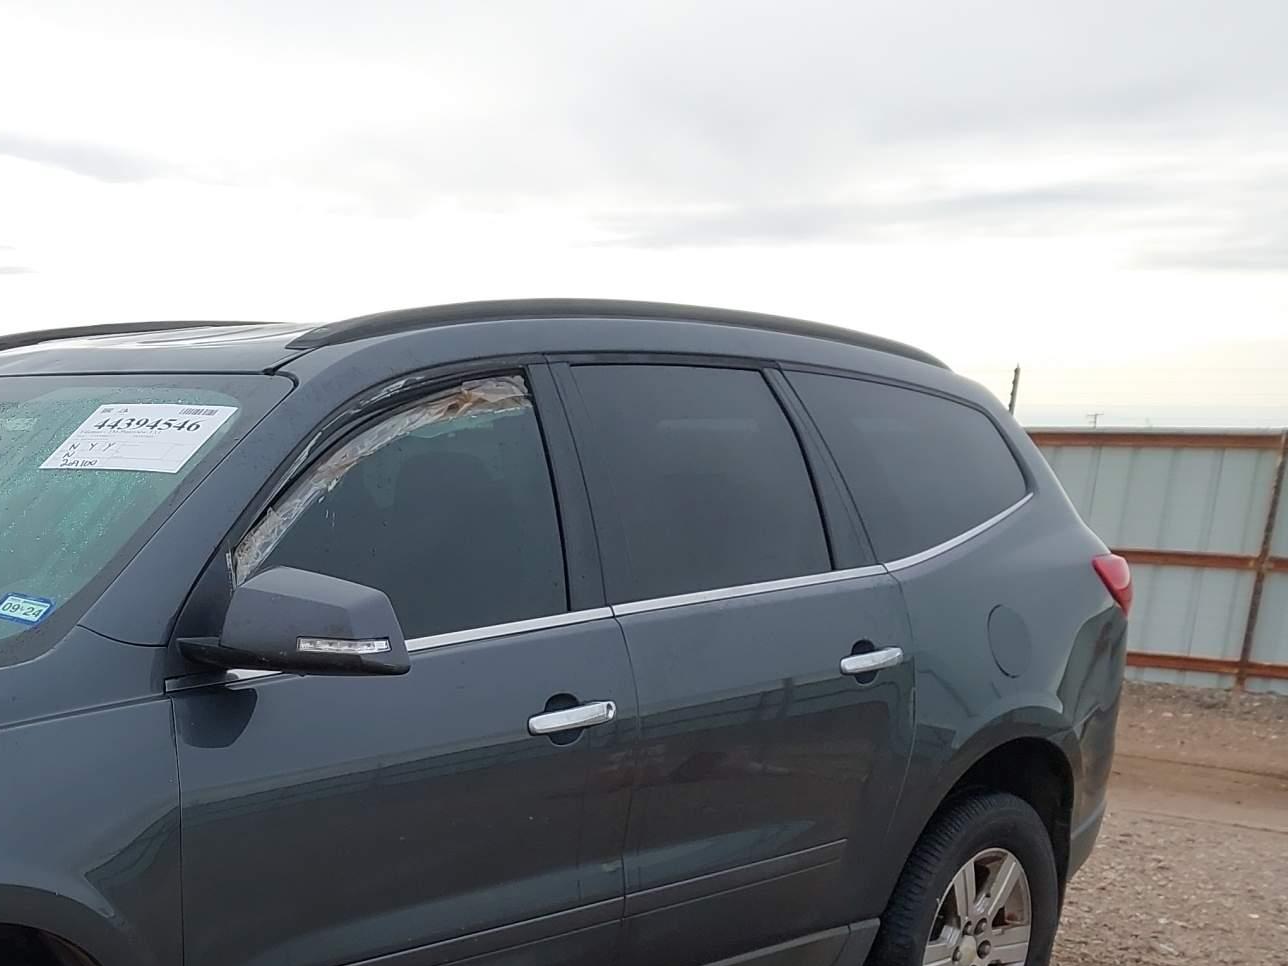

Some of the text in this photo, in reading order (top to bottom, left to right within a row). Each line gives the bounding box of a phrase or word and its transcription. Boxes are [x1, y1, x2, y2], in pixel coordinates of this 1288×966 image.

[94, 417, 201, 432] 44394546
[2, 602, 43, 617] 09 24
